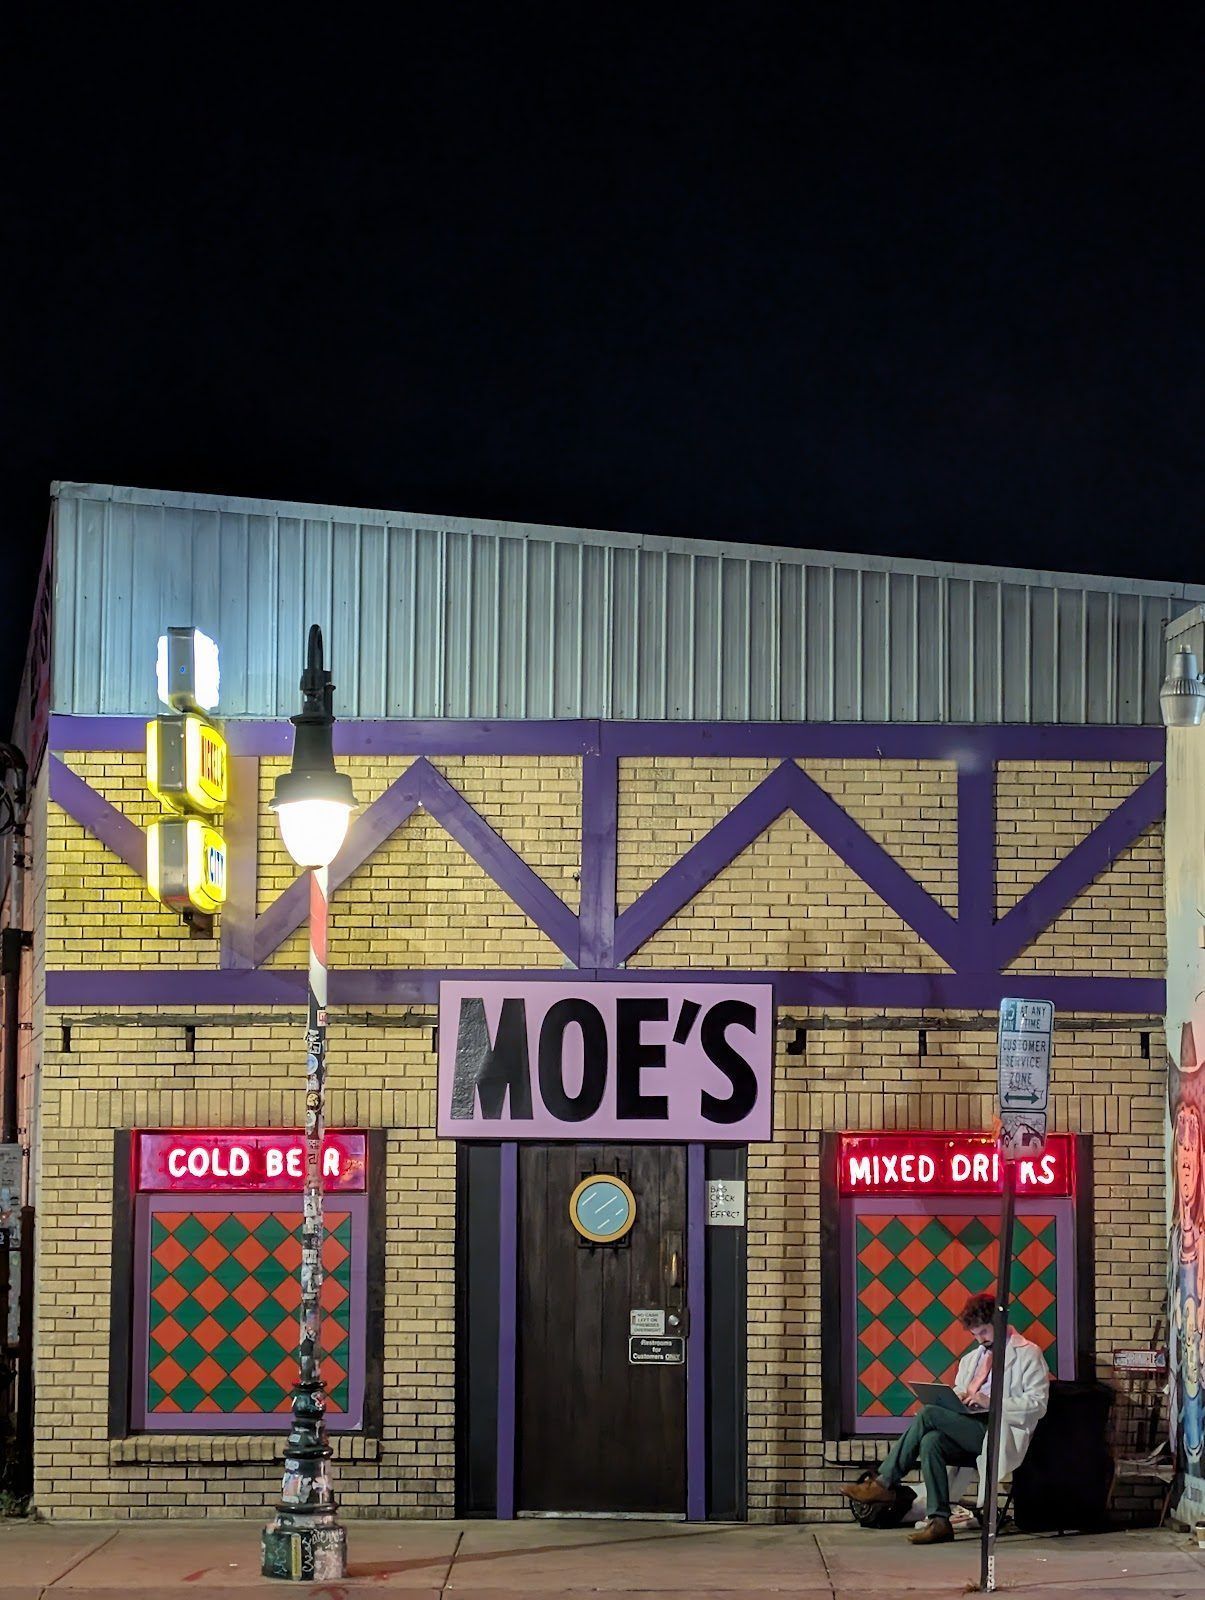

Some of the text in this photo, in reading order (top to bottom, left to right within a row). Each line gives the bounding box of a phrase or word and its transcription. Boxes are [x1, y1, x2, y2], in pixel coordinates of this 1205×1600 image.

[1020, 1005, 1047, 1017] AT ANY
[1024, 1018, 1041, 1030] TIME
[1002, 1039, 1046, 1052] CUSTOMER
[450, 997, 758, 1124] MOE'S
[1006, 1055, 1041, 1069] SERVICE
[1010, 1072, 1033, 1085] ZONE
[168, 1147, 340, 1177] COLD BER
[850, 1153, 1056, 1186] MIXED DRIKS
[632, 1352, 664, 1360] Customers
